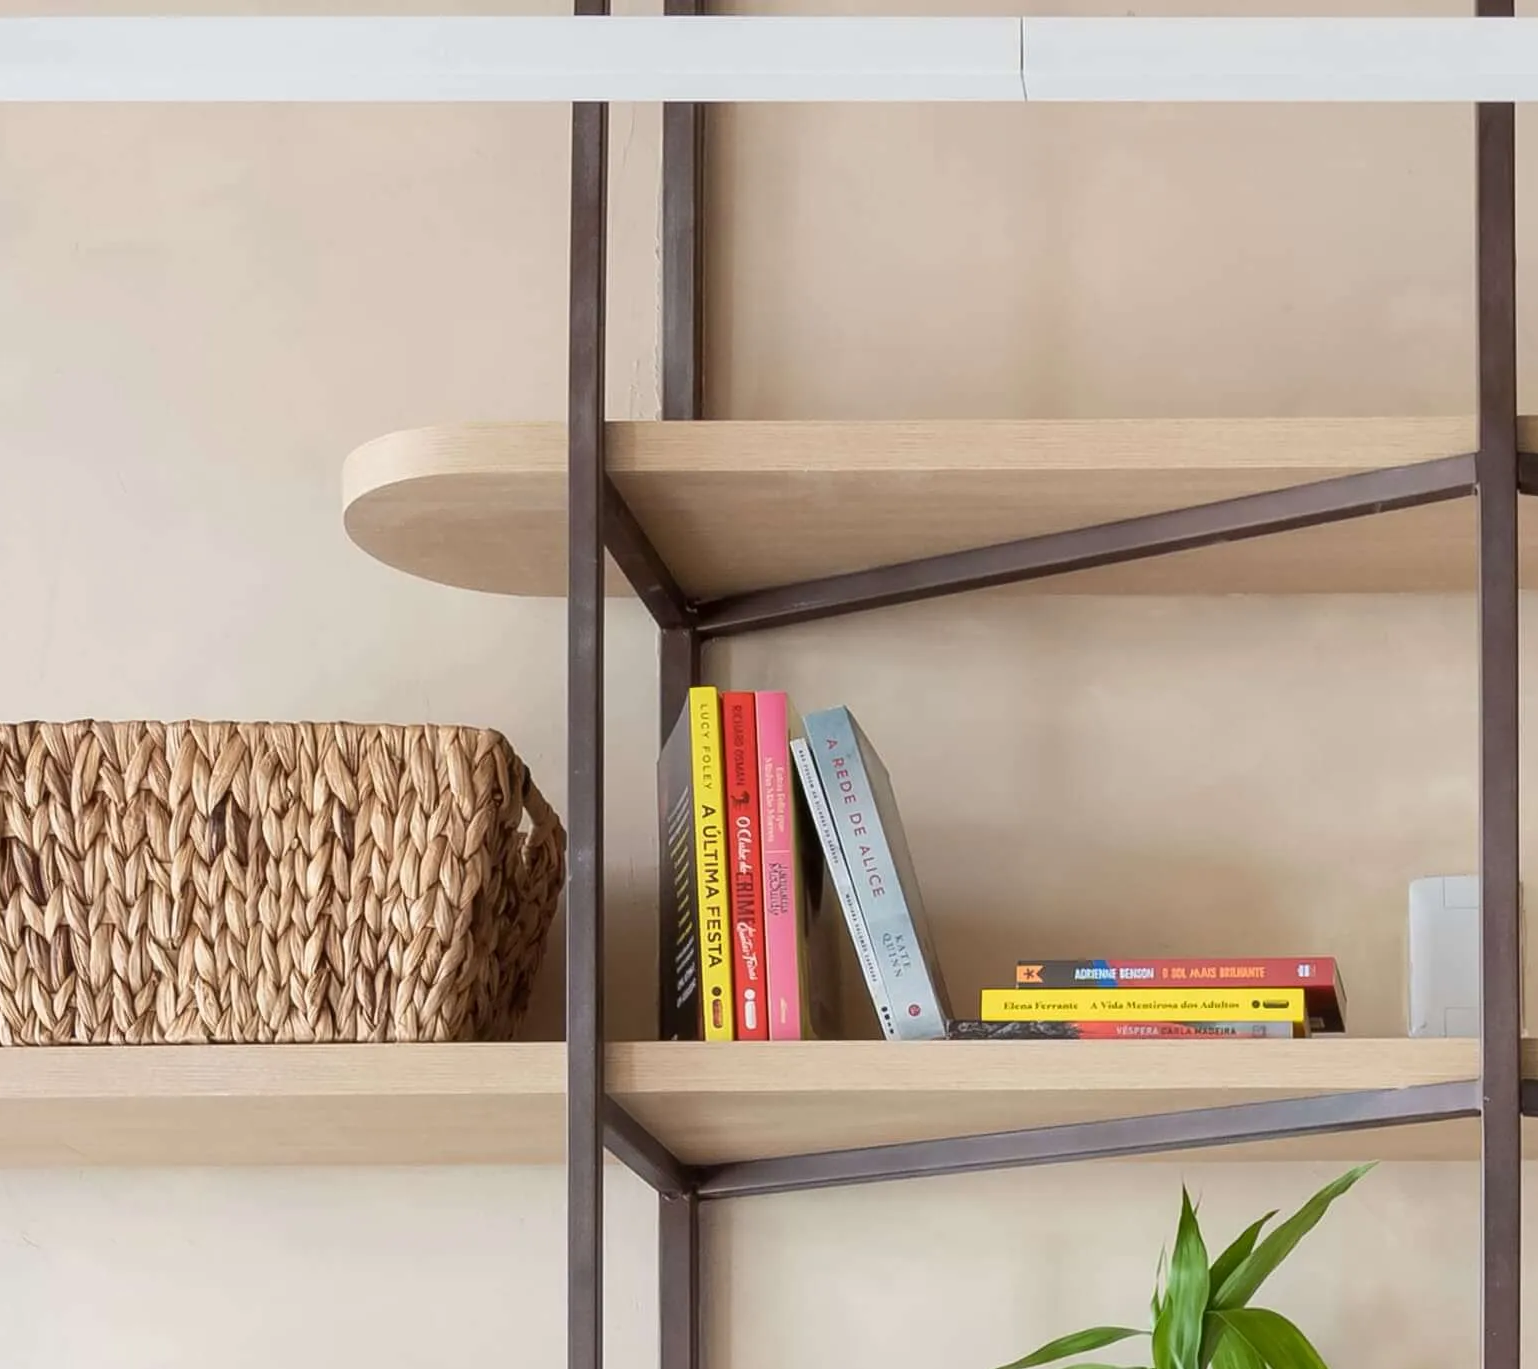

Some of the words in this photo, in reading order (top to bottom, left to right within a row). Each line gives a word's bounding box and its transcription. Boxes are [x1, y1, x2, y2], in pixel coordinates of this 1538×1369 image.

[700, 704, 710, 739] LUCY
[733, 704, 744, 747] RICHARD
[826, 739, 838, 750] A
[702, 745, 713, 789] FOLEY
[734, 748, 745, 786] OSMAN
[831, 757, 857, 805] REDE
[702, 805, 716, 818] A
[736, 816, 750, 828] O
[849, 812, 867, 837] DE
[737, 828, 752, 860] Clube
[702, 825, 721, 899] ÚLTIMA
[859, 845, 885, 898] ALICE
[735, 872, 756, 924] CRIME
[706, 906, 723, 968] FESTA
[895, 934, 911, 967] KATE
[882, 932, 903, 978] QUINN
[1074, 968, 1117, 981] ADRIENNE
[1119, 968, 1155, 980] BENSON
[1171, 967, 1187, 979] SOL
[1189, 967, 1216, 979] MAIS
[1219, 966, 1266, 979] BRILHANTE
[1003, 1001, 1032, 1010] Elena
[1034, 1001, 1078, 1010] Ferrante
[1090, 1001, 1098, 1010] A
[1101, 1001, 1124, 1010] Vida
[1126, 1000, 1178, 1010] Mentirosa
[1180, 1000, 1198, 1009] dos
[1200, 1000, 1240, 1009] Adultos
[1116, 1024, 1159, 1035] VÉSPERA
[1161, 1026, 1191, 1035] CARLA
[1194, 1026, 1237, 1035] MADEIRA
